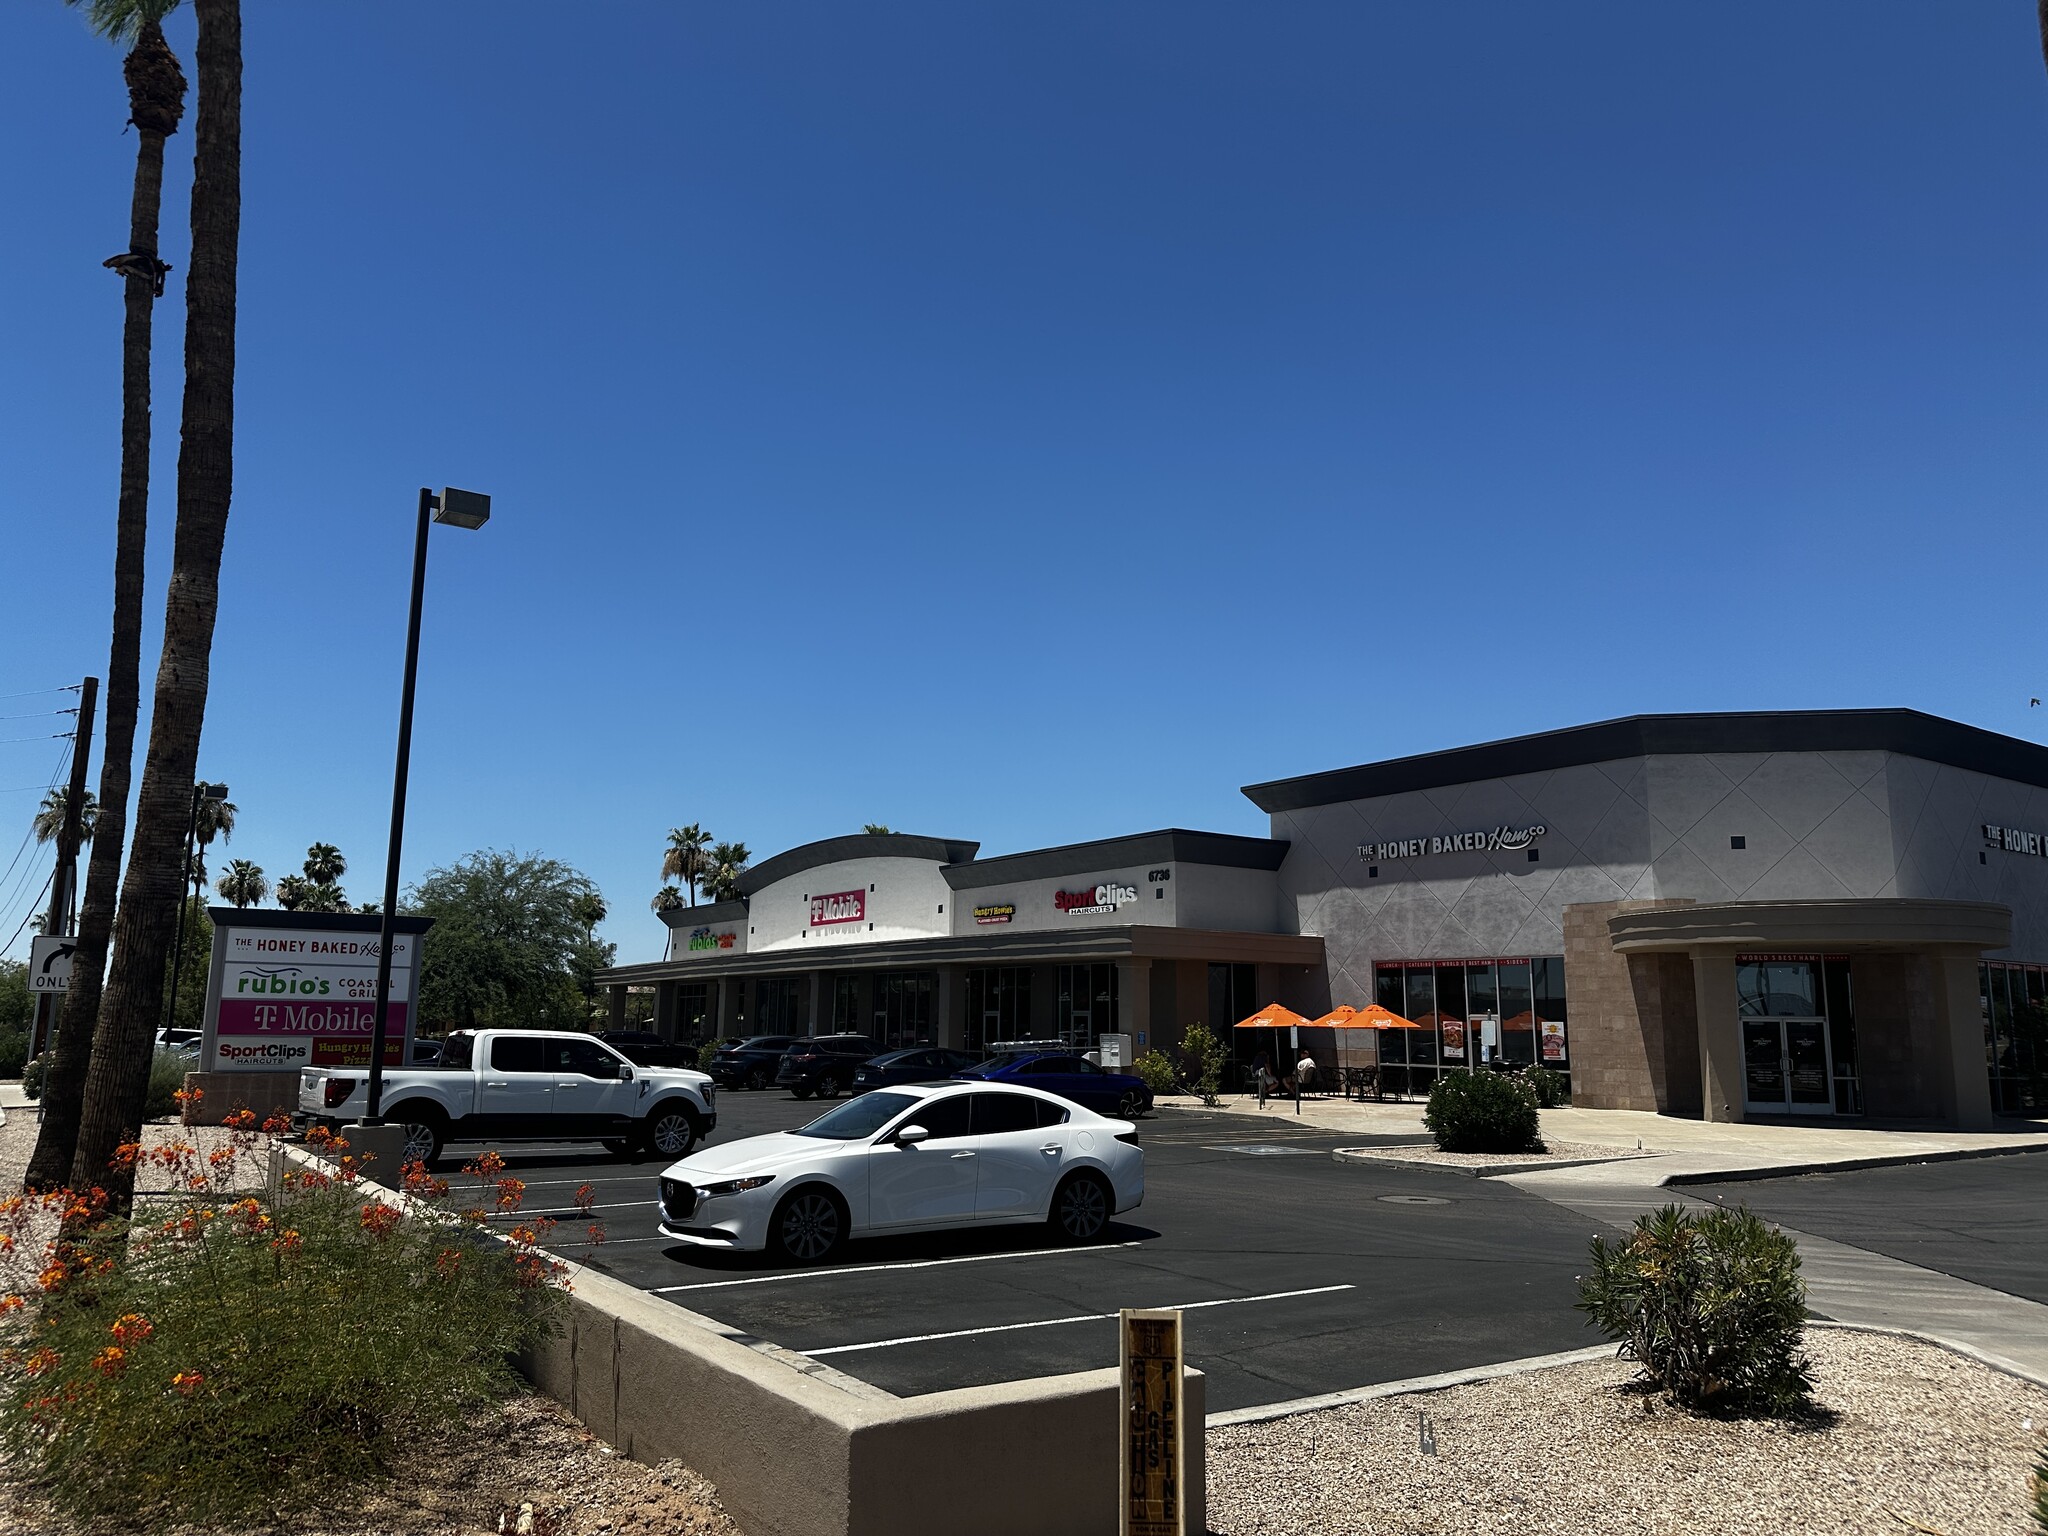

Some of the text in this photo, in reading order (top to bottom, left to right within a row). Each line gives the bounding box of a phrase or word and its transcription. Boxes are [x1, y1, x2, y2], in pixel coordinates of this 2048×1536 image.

[1357, 844, 1374, 856] THE
[1378, 838, 1429, 860] HONEY
[1432, 831, 1487, 854] BAKED
[1487, 825, 1533, 850] Ham
[1985, 824, 2002, 840] THE
[2003, 827, 2042, 856] HONEY
[1148, 869, 1171, 882] 6736
[1055, 884, 1138, 913] SportClips
[1070, 905, 1111, 915] HAIRCUTS
[235, 938, 253, 946] THE
[257, 939, 306, 952] HONEY
[311, 941, 358, 954] BAKED
[359, 941, 392, 957] Ha
[238, 972, 330, 994] rubio's
[339, 978, 395, 988] COASTL
[349, 989, 378, 998] GRIL
[282, 1006, 375, 1031] Mobile
[219, 1043, 307, 1060] SportClips
[318, 1042, 400, 1054] Hungry Hie's
[361, 1078, 391, 1086] F4
[1148, 1411, 1159, 1468] GAS
[1162, 1361, 1175, 1519] PIPELINE
